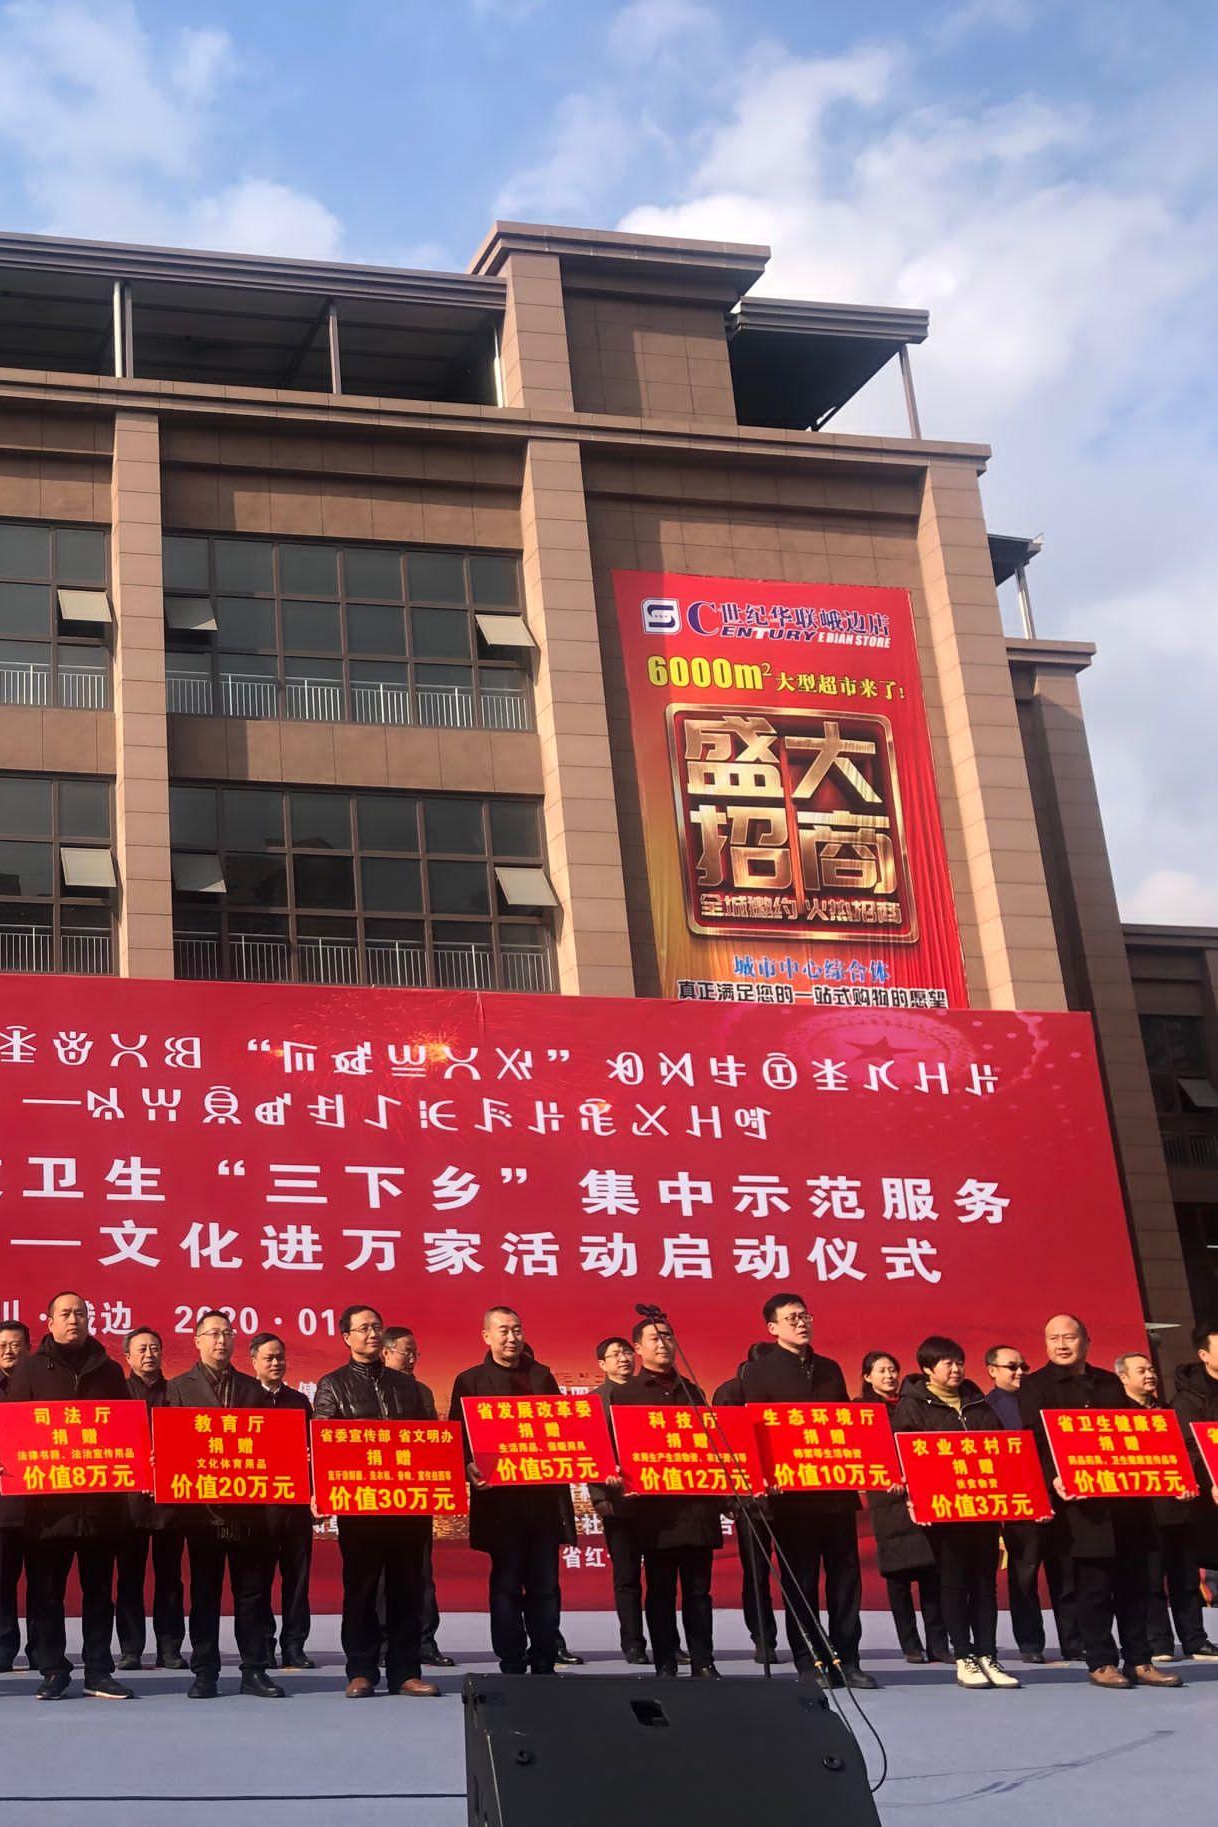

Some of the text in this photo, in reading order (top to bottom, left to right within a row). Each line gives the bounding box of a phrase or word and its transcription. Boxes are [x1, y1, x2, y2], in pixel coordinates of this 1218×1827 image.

[720, 603, 890, 636] 世纪华联峨边店
[817, 632, 892, 648] E BIAN STORE
[684, 715, 883, 803] 盛大
[690, 804, 899, 895] 招商
[700, 893, 902, 925] 全城邀约 火热招商
[733, 953, 891, 984] 城市中心综合体
[678, 979, 948, 1009] 真正满足您的一站式购物的愿望
[34, 1406, 111, 1426] 司法厅
[477, 1400, 592, 1420] 省发展改革委
[647, 1411, 718, 1429] 科技厅
[763, 1408, 875, 1426] 生态环境厅
[194, 1414, 265, 1434] 教育厅
[518, 1421, 560, 1438] 捐赠
[1057, 1414, 1168, 1432] 省卫生健康委
[52, 1428, 98, 1446] 捐赠
[320, 1428, 454, 1443] 省委宣传部 省文明办
[666, 1432, 708, 1448] 捐赠
[803, 1428, 846, 1445] 捐赠
[1099, 1435, 1140, 1452] 捐赠
[208, 1437, 254, 1455] 捐赠
[912, 1437, 1022, 1456] 农业农村厅
[197, 1457, 267, 1470] 文化体育用品
[367, 1449, 412, 1466] 捐赠
[952, 1458, 994, 1475] 捐赠
[23, 1464, 136, 1490] 价值8万元
[496, 1456, 600, 1482] 价值5万元
[640, 1467, 753, 1490] 价值12万元
[774, 1463, 893, 1487] 价值10万元
[170, 1473, 296, 1500] 价值20万元
[1074, 1469, 1186, 1493] 价值17万元
[329, 1485, 456, 1511] 价值30万元
[932, 1493, 1034, 1519] 价值3万元
